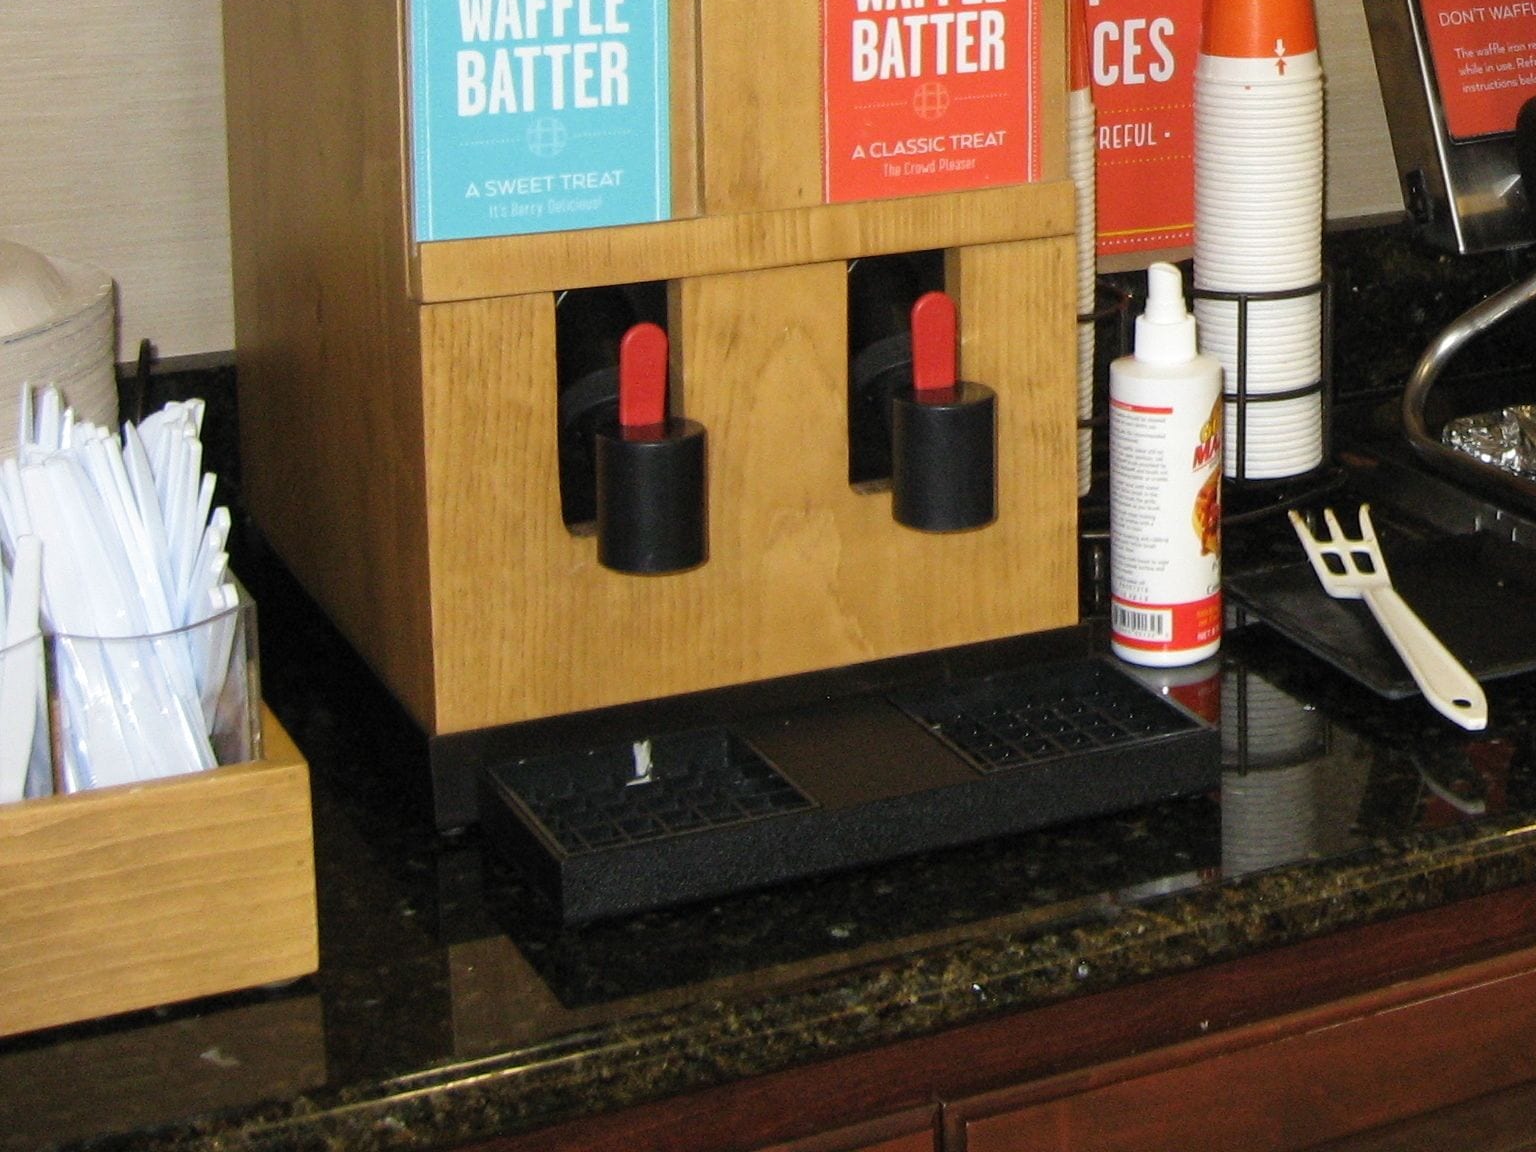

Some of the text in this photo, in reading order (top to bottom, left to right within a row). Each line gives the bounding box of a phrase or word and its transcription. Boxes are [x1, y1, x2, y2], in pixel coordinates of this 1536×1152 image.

[1438, 7, 1485, 27] DON'T
[852, 9, 1006, 82] BATTER
[1093, 17, 1175, 87] CES
[1454, 47, 1474, 59] The
[1475, 42, 1506, 56] waffle
[1507, 43, 1526, 53] iron
[457, 42, 628, 117] BATTER
[1458, 63, 1484, 76] while
[1484, 62, 1495, 73] in
[1462, 77, 1518, 93] instructions
[851, 130, 1007, 160] A CLASSIC TREAT
[1099, 122, 1157, 149] REFUL
[883, 158, 976, 177] The Crowd Pleaser
[465, 169, 624, 198] A SWEET TREAT
